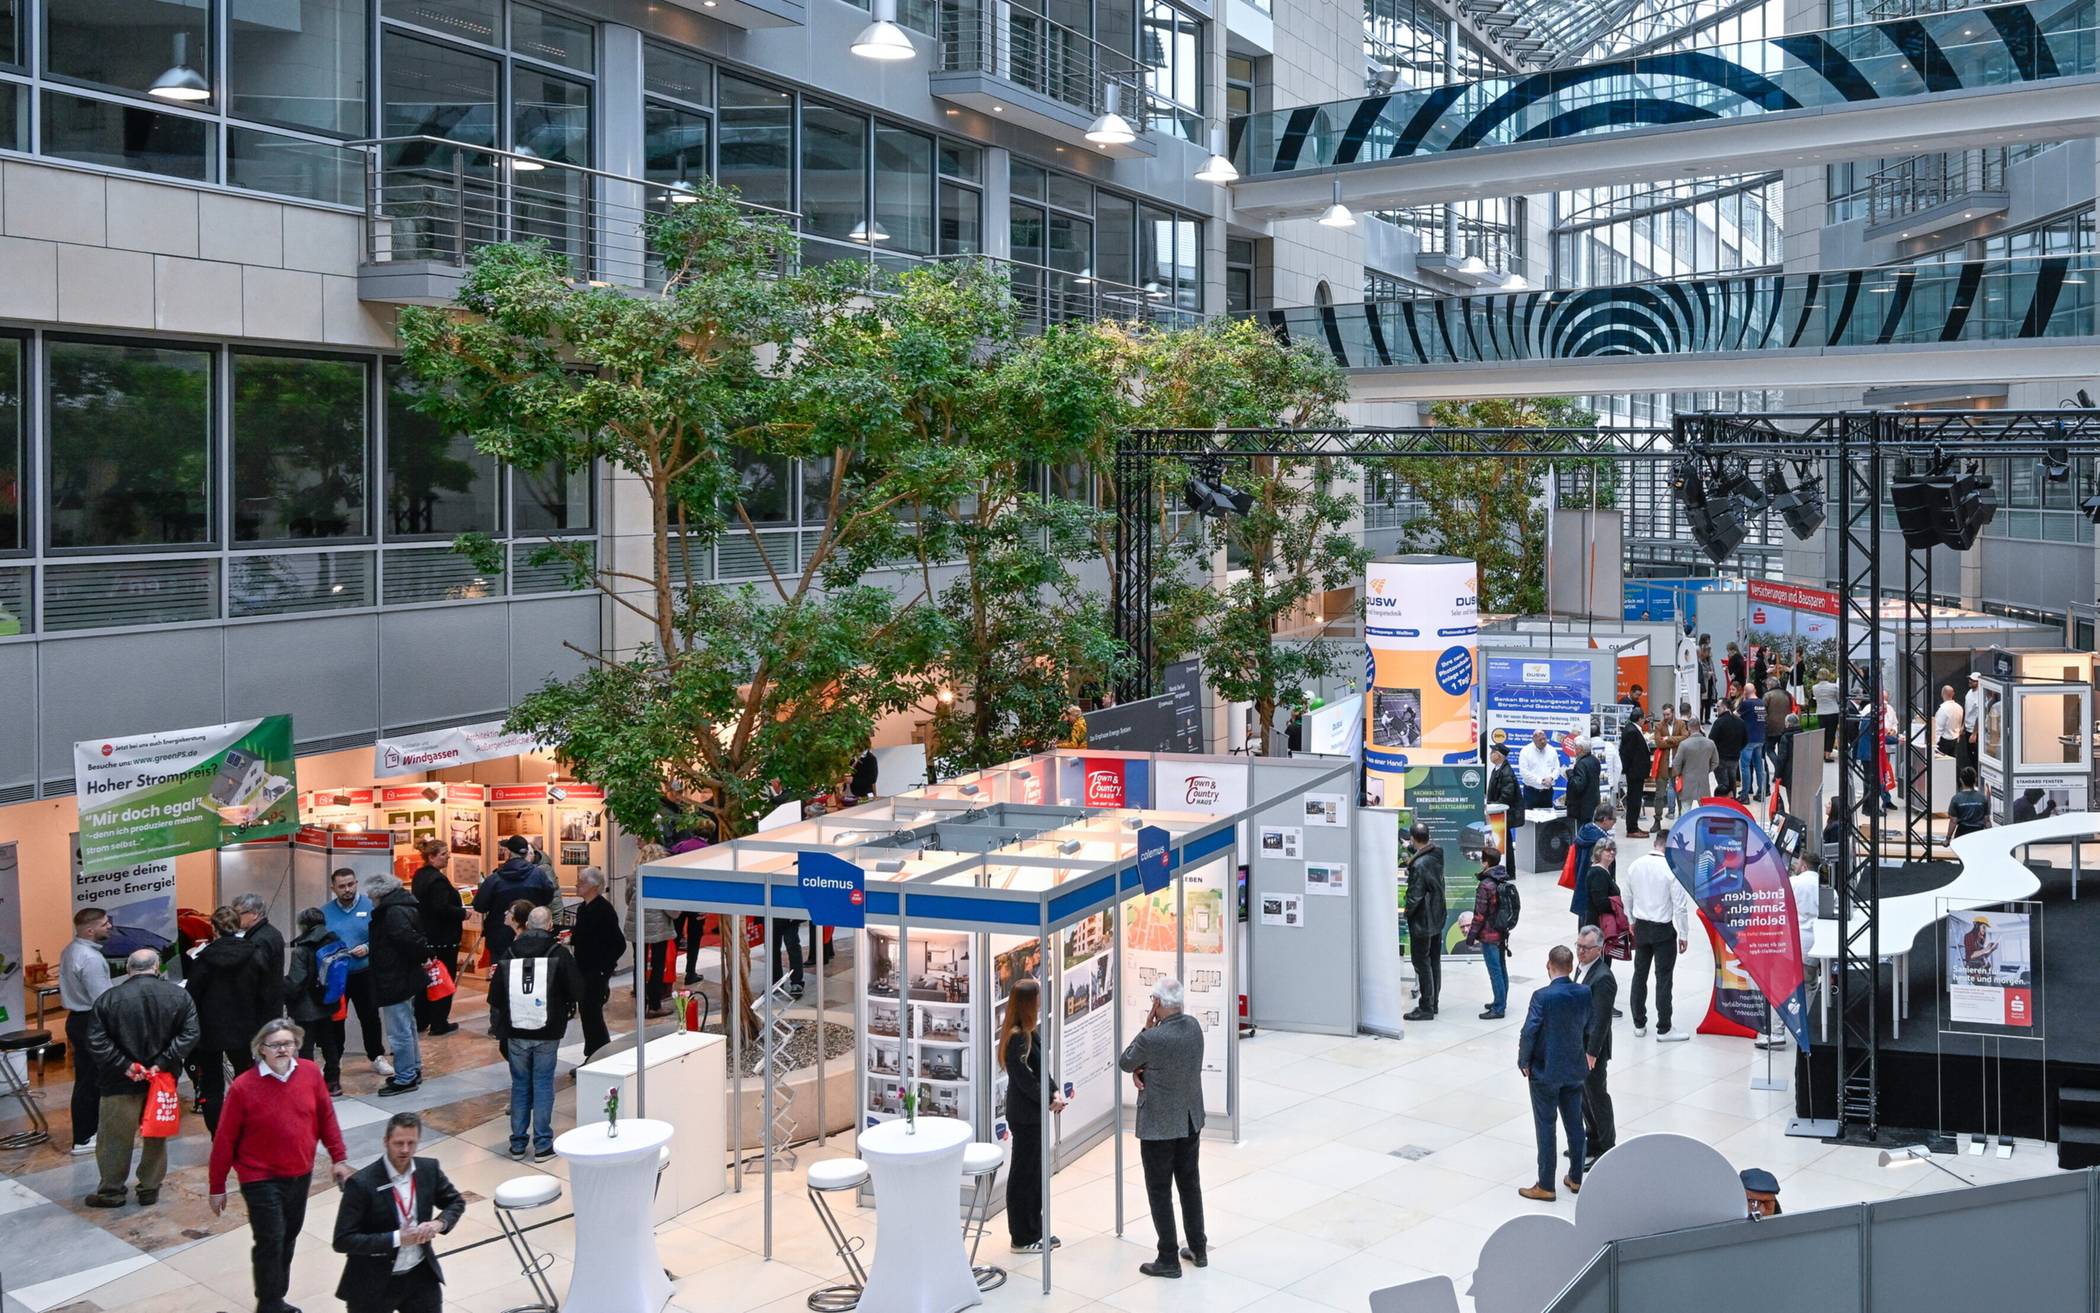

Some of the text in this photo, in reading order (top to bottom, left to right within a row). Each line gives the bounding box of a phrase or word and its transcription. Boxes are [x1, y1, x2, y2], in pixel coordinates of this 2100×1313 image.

[1751, 583, 1788, 602] Versicherungen
[1788, 593, 1797, 603] und
[1799, 591, 1825, 608] Bausparen
[115, 744, 128, 752] Jetzt
[87, 762, 117, 771] Besuche
[133, 749, 198, 765] www.greenPS.de
[402, 748, 459, 766] Windgassen
[87, 762, 219, 795] Hoher Strompreis?
[1088, 770, 1119, 785] Town &
[1185, 775, 1216, 790] Town &
[1089, 781, 1122, 799] Country
[1186, 786, 1219, 804] Country
[121, 804, 160, 821] doch
[116, 827, 129, 836] ich
[130, 820, 173, 835] produziere
[174, 814, 203, 825] meinen
[86, 845, 110, 855] Strom
[1141, 845, 1165, 861] colemus
[76, 864, 168, 885] Erzeuge deine
[802, 876, 854, 890] colemus
[76, 875, 176, 902] eigene Energie!
[1952, 965, 1987, 975] Sanieren
[1952, 973, 1975, 983] heute
[1977, 975, 1992, 983] und
